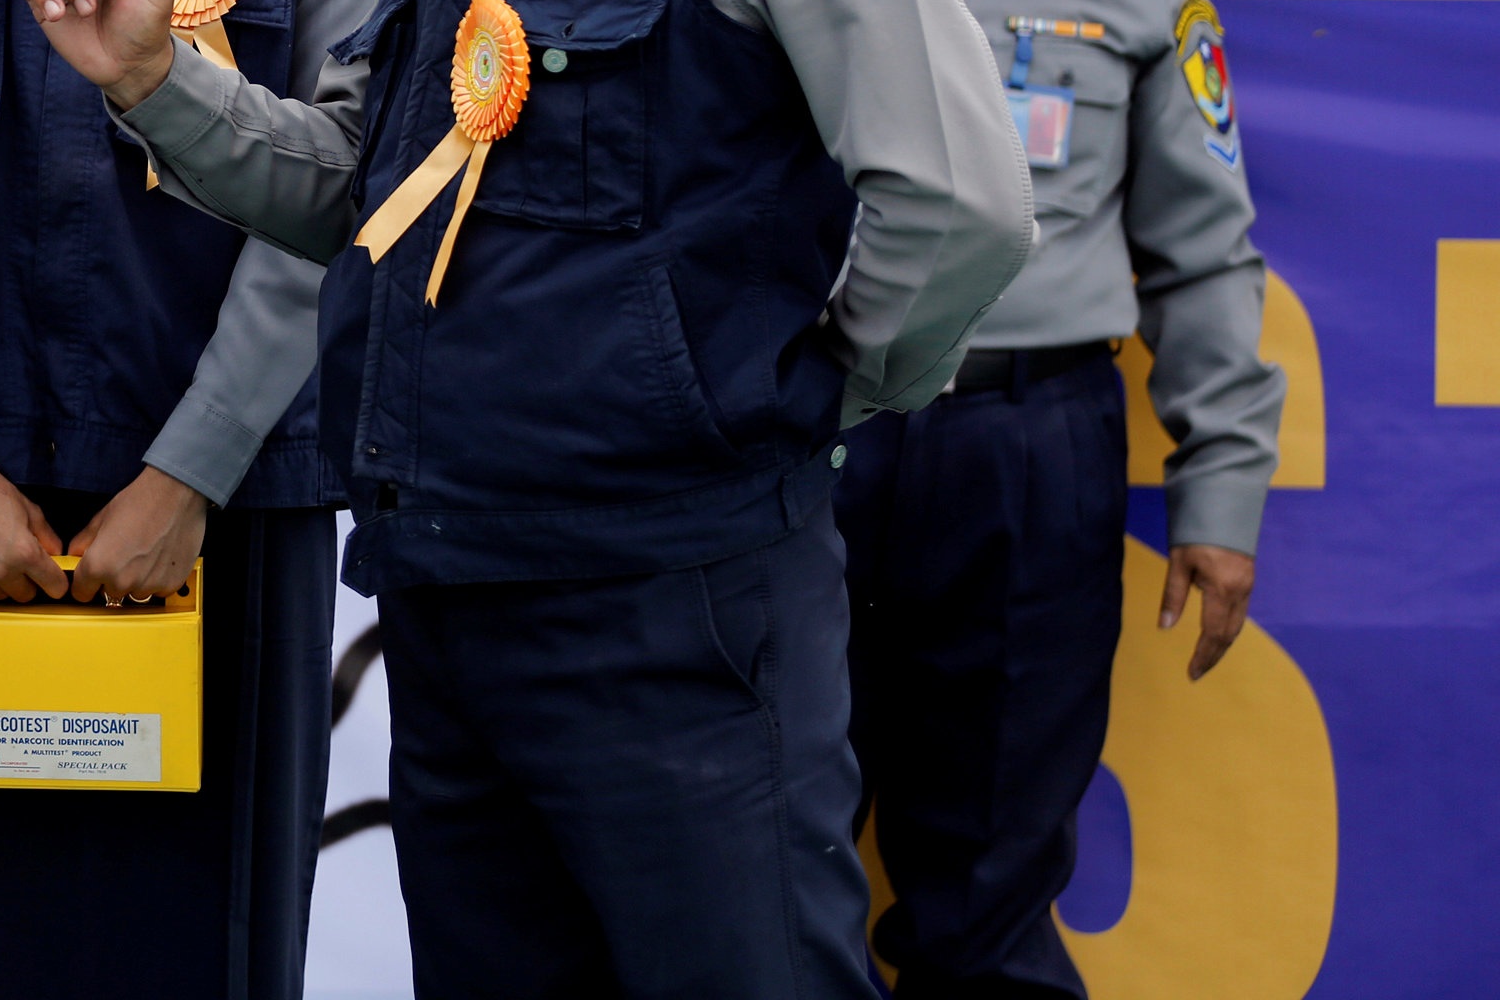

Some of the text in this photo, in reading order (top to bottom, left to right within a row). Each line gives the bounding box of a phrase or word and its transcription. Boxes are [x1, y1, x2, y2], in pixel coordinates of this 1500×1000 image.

[62, 718, 139, 735] DISPOSAKIT
[11, 737, 55, 746] NARCOTIC
[58, 738, 124, 747] IDENTIFICATION
[57, 761, 128, 770] SPECIAL PACK
